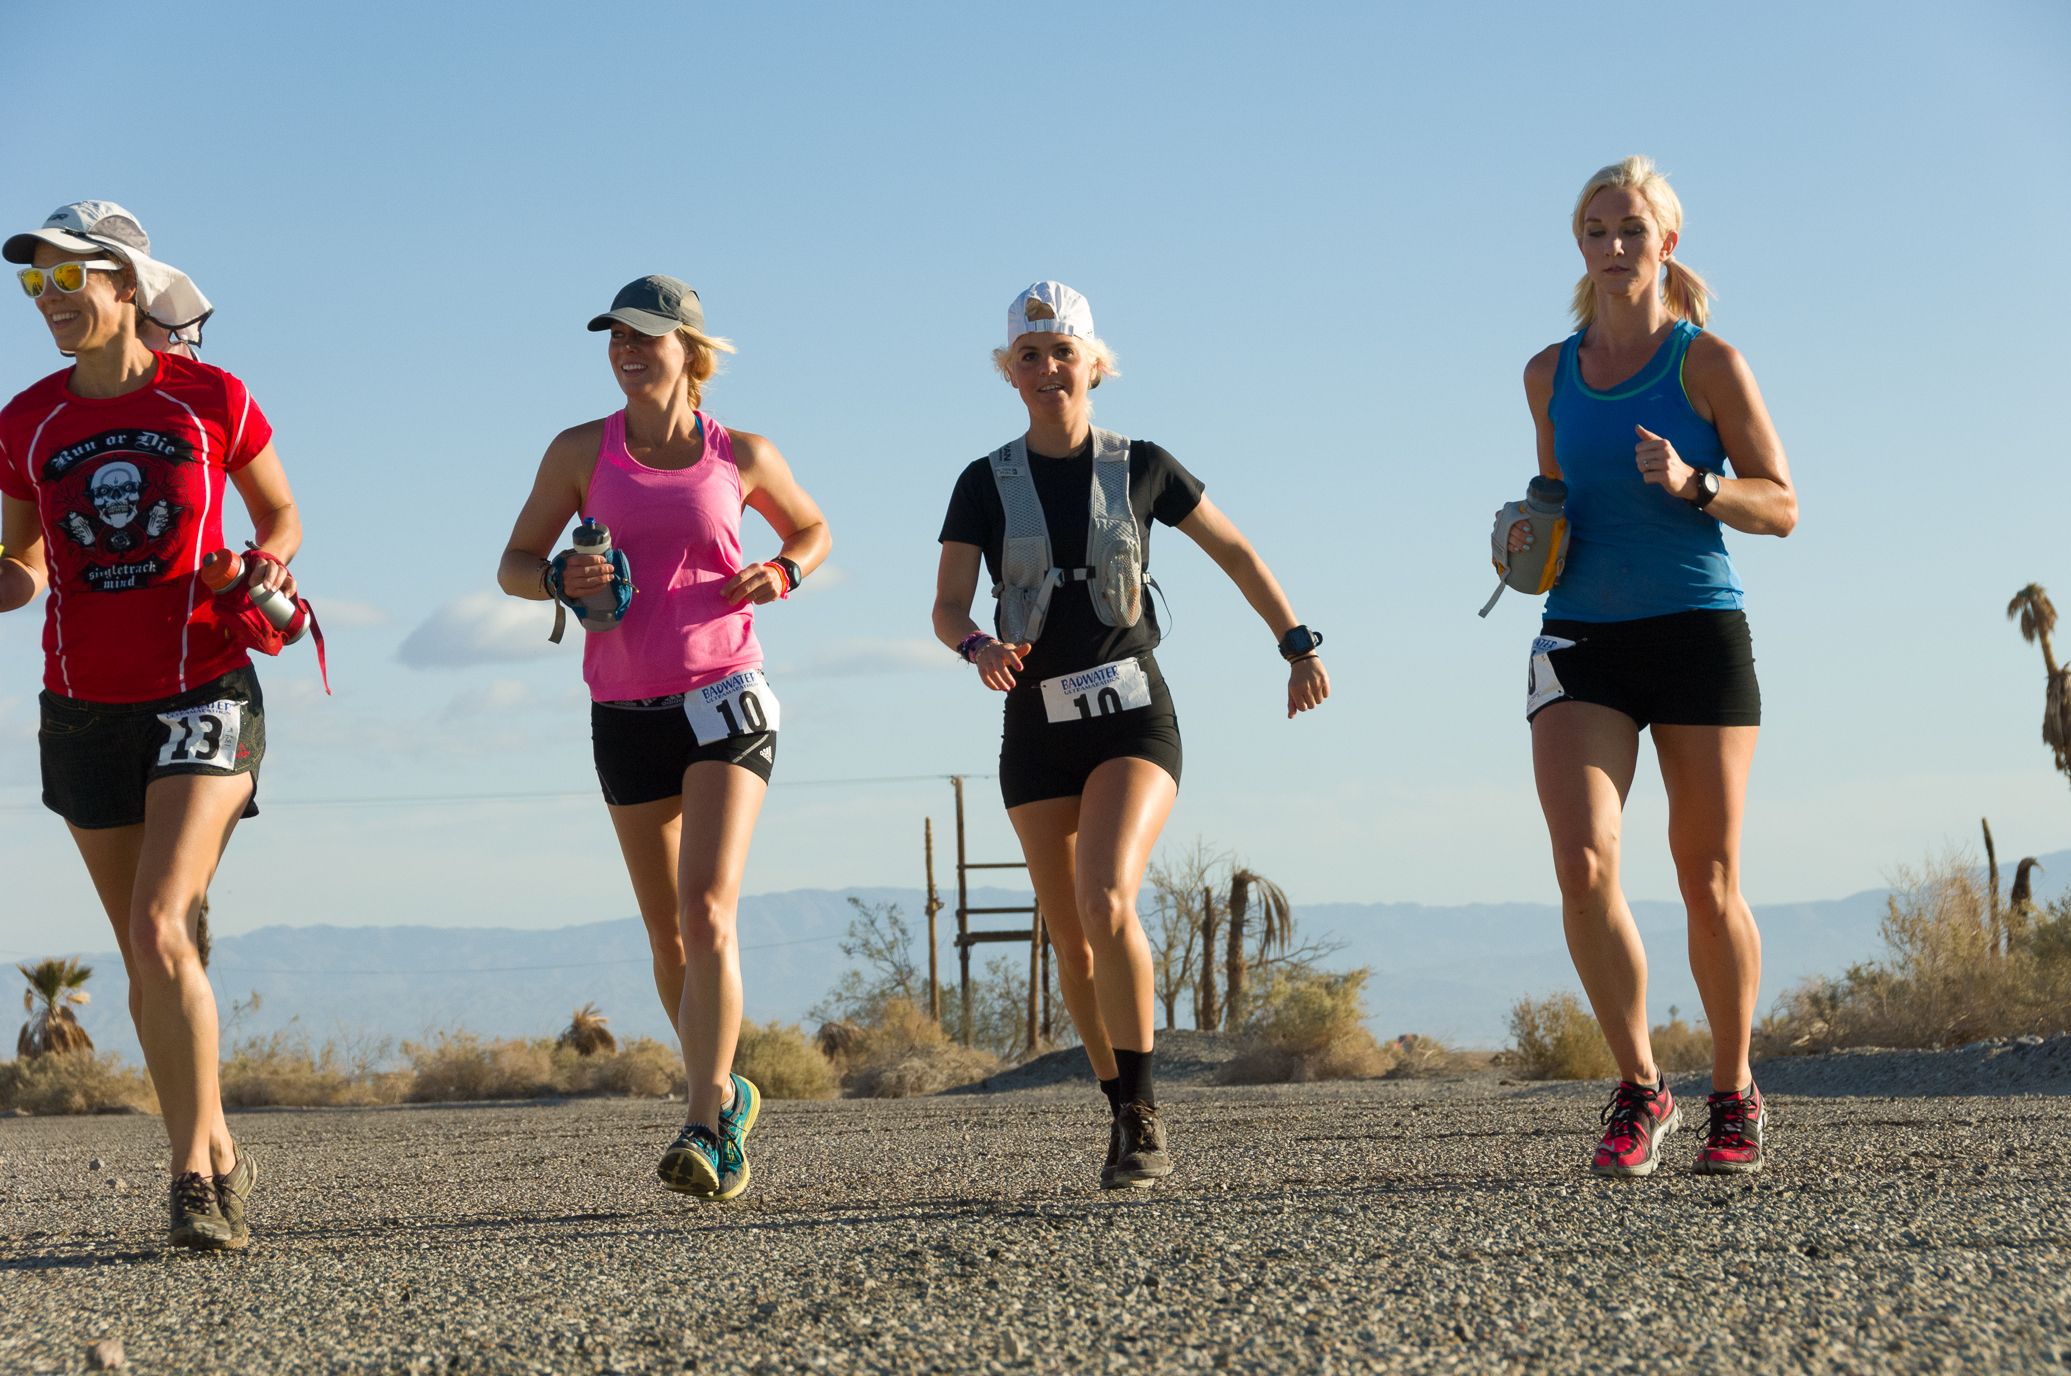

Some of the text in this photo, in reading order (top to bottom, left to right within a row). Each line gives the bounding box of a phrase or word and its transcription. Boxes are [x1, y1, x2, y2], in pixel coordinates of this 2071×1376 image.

[51, 431, 175, 471] Run or Die
[88, 560, 156, 580] singletrack
[103, 575, 135, 589] mind
[701, 671, 756, 700] BADWATER
[1060, 664, 1119, 691] BADWATER
[1063, 676, 1121, 696] ULTRAMARATHON
[661, 697, 684, 706] adida
[715, 690, 768, 738] 10
[1073, 686, 1124, 720] 10
[170, 714, 223, 761] 13
